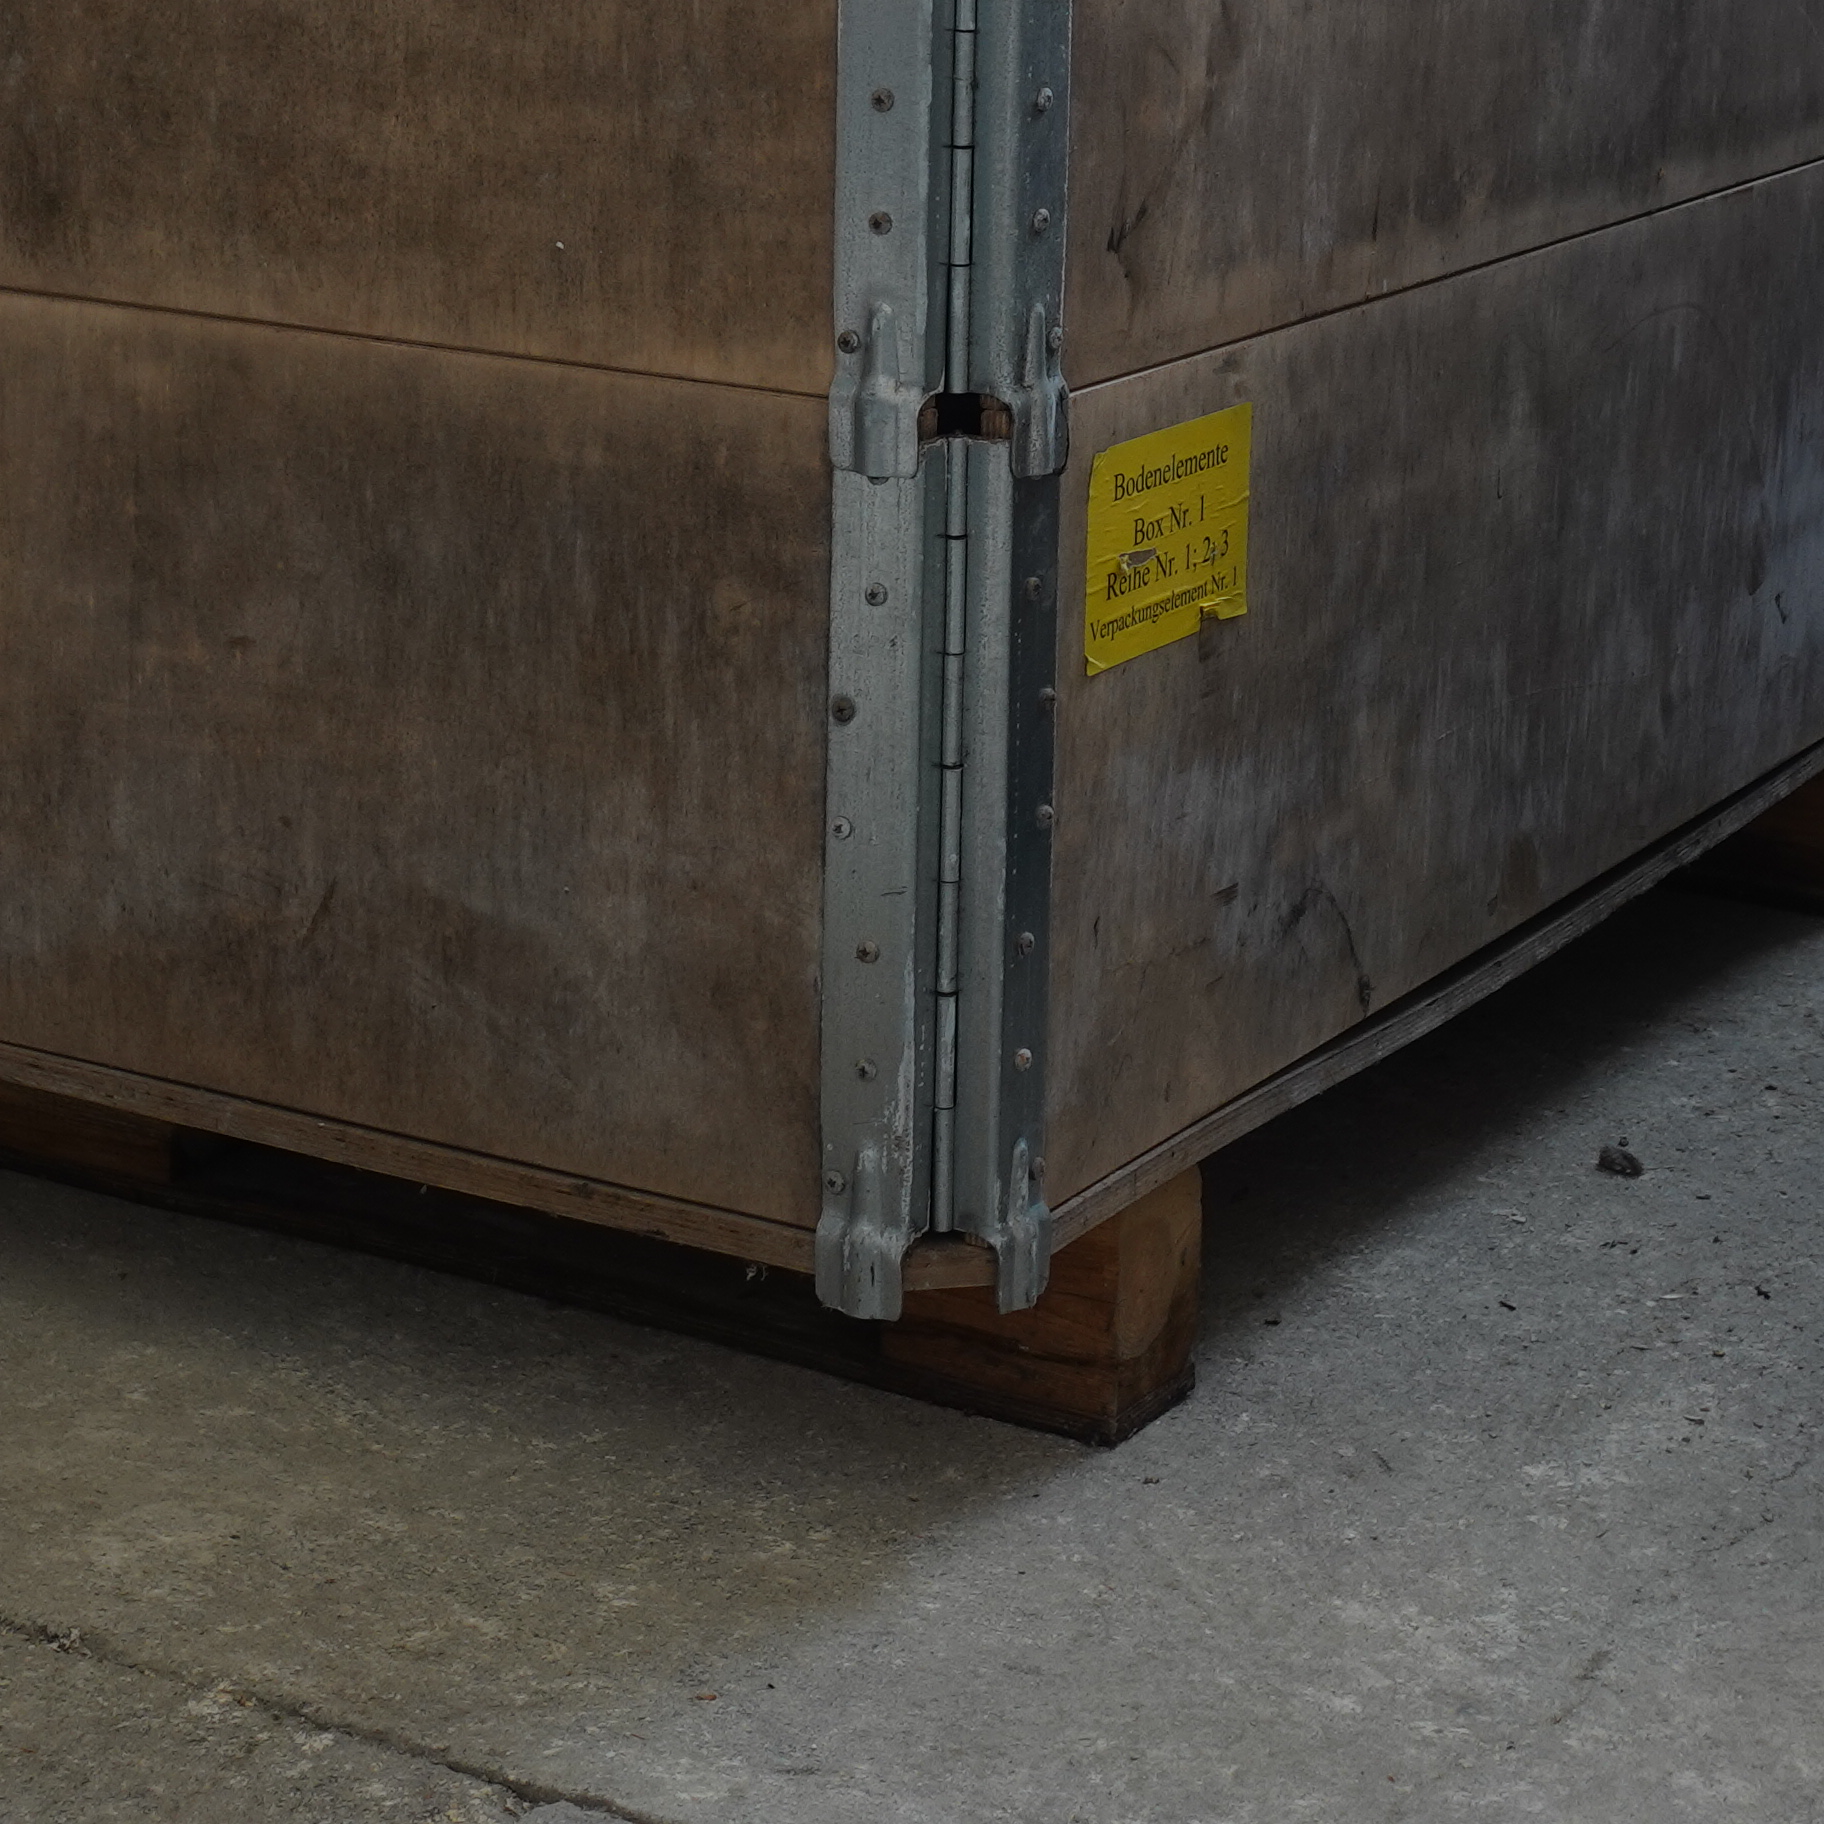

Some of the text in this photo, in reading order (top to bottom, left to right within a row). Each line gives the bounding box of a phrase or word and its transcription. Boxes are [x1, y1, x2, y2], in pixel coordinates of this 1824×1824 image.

[1114, 443, 1229, 502] Bodenelemente
[1134, 495, 1205, 546] Box Nr. 1
[1106, 566, 1150, 601] Reihe
[1155, 551, 1178, 583] Nr.
[1185, 543, 1197, 572] 1;
[1220, 530, 1229, 557] 3
[1089, 566, 1237, 642] Verpackungselement Nr. 1
